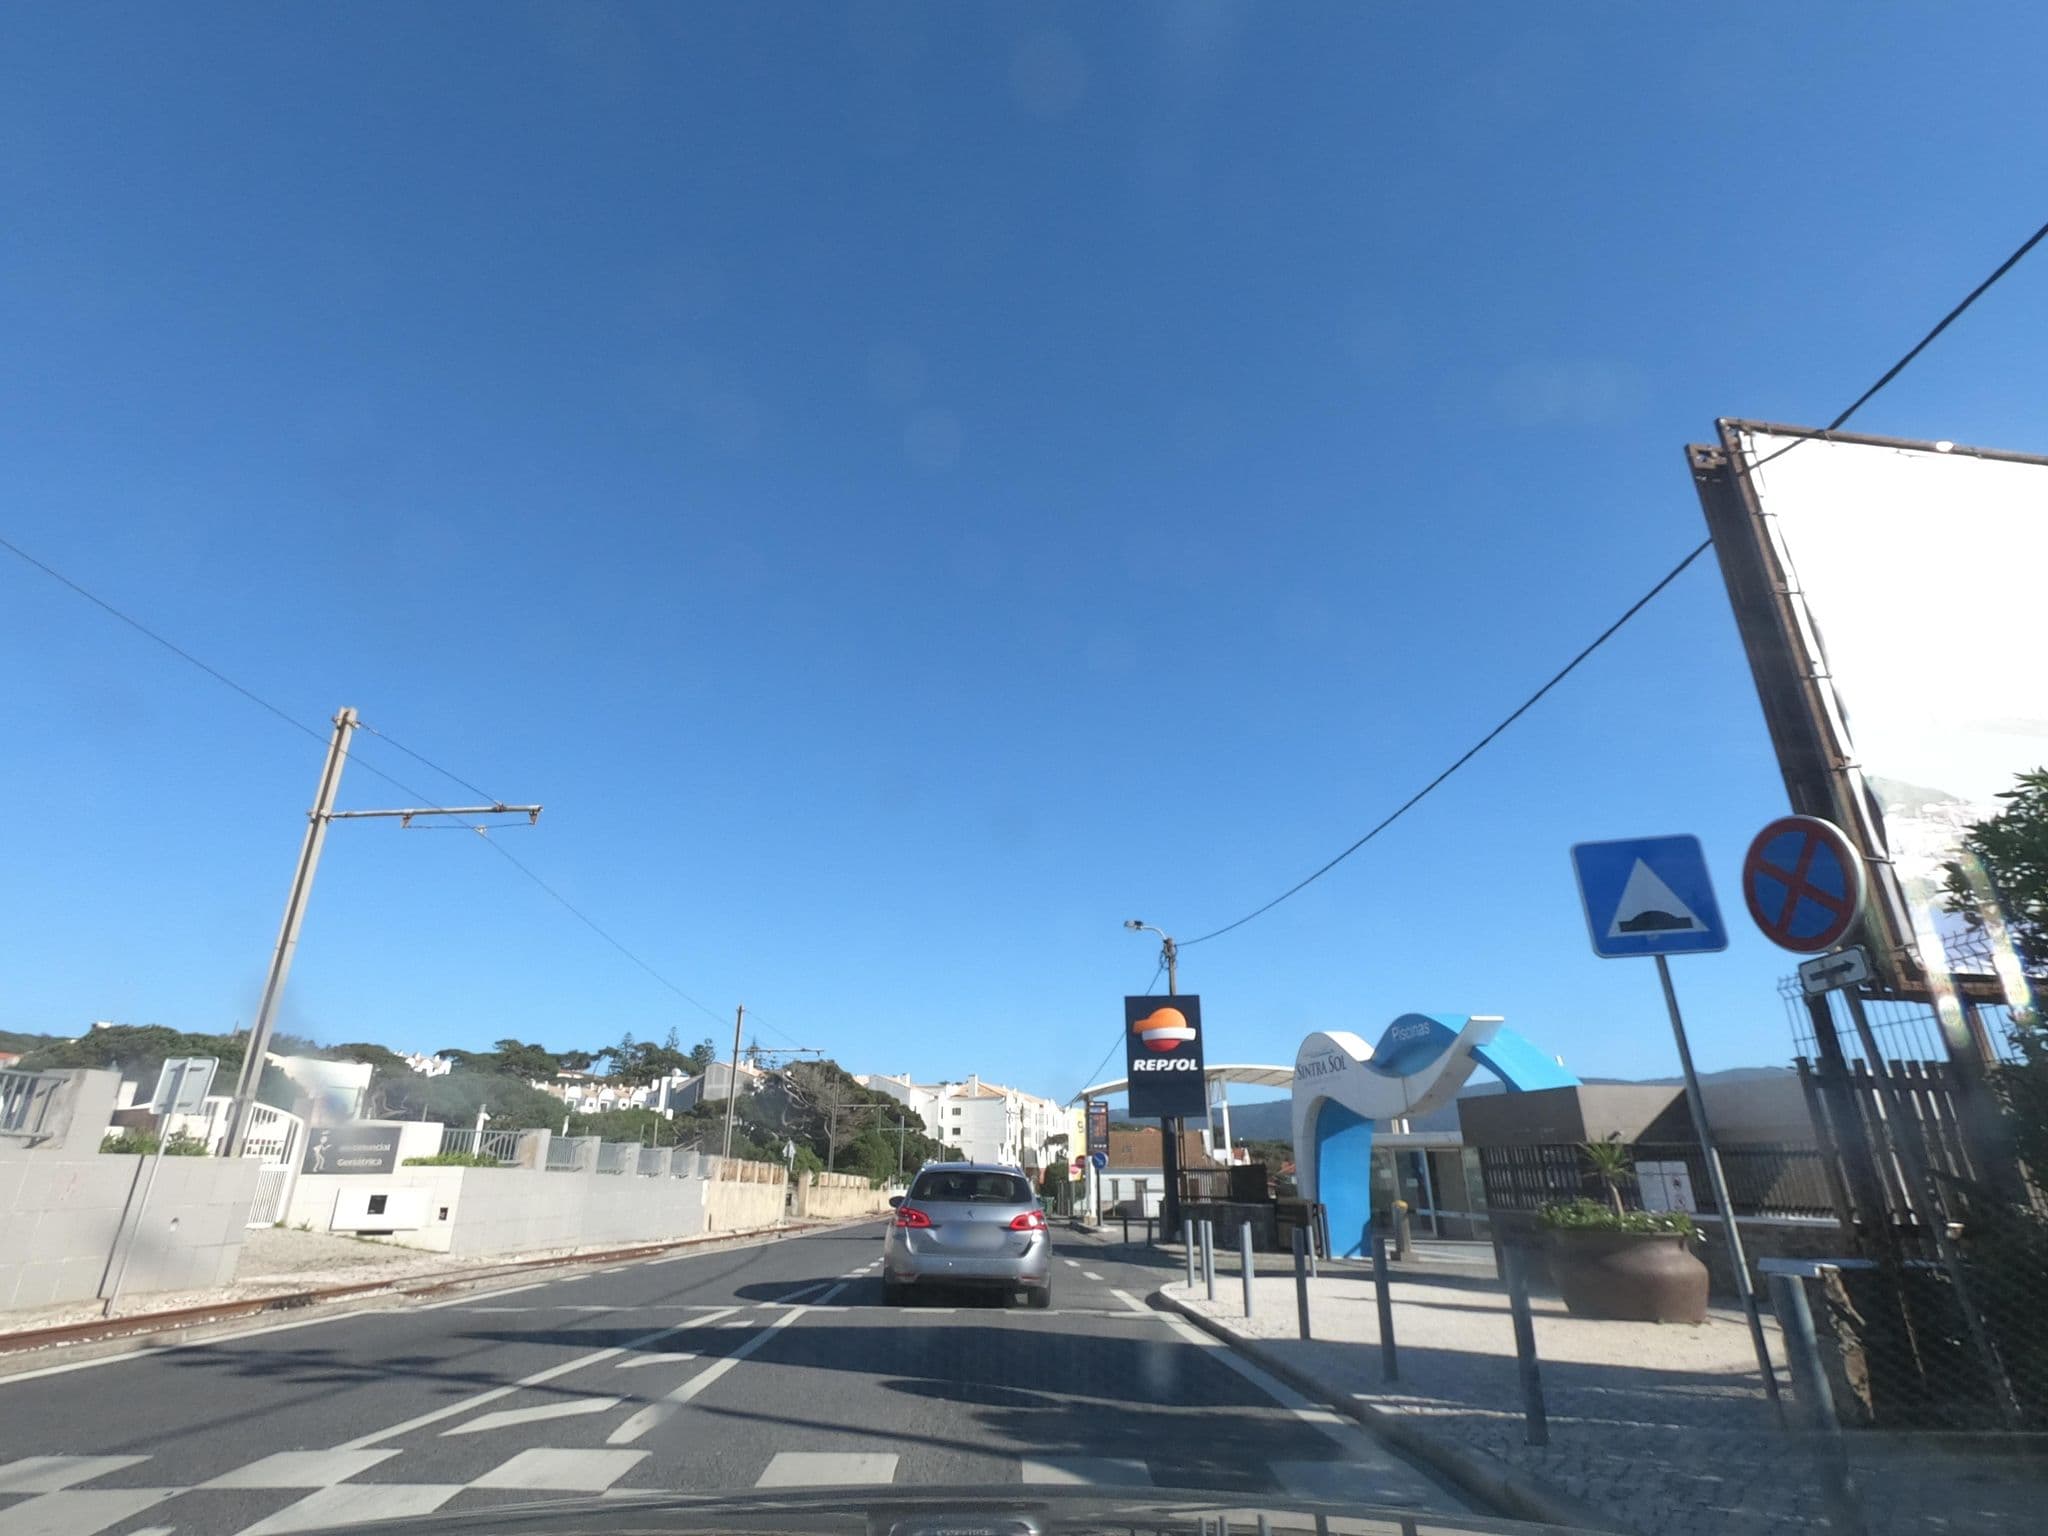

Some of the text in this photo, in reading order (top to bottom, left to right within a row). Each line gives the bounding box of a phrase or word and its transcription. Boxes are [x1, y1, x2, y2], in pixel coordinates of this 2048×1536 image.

[1391, 1021, 1430, 1041] Piscinas
[1133, 1058, 1198, 1071] REPSOL
[1296, 1055, 1347, 1081] SINTRA SOL
